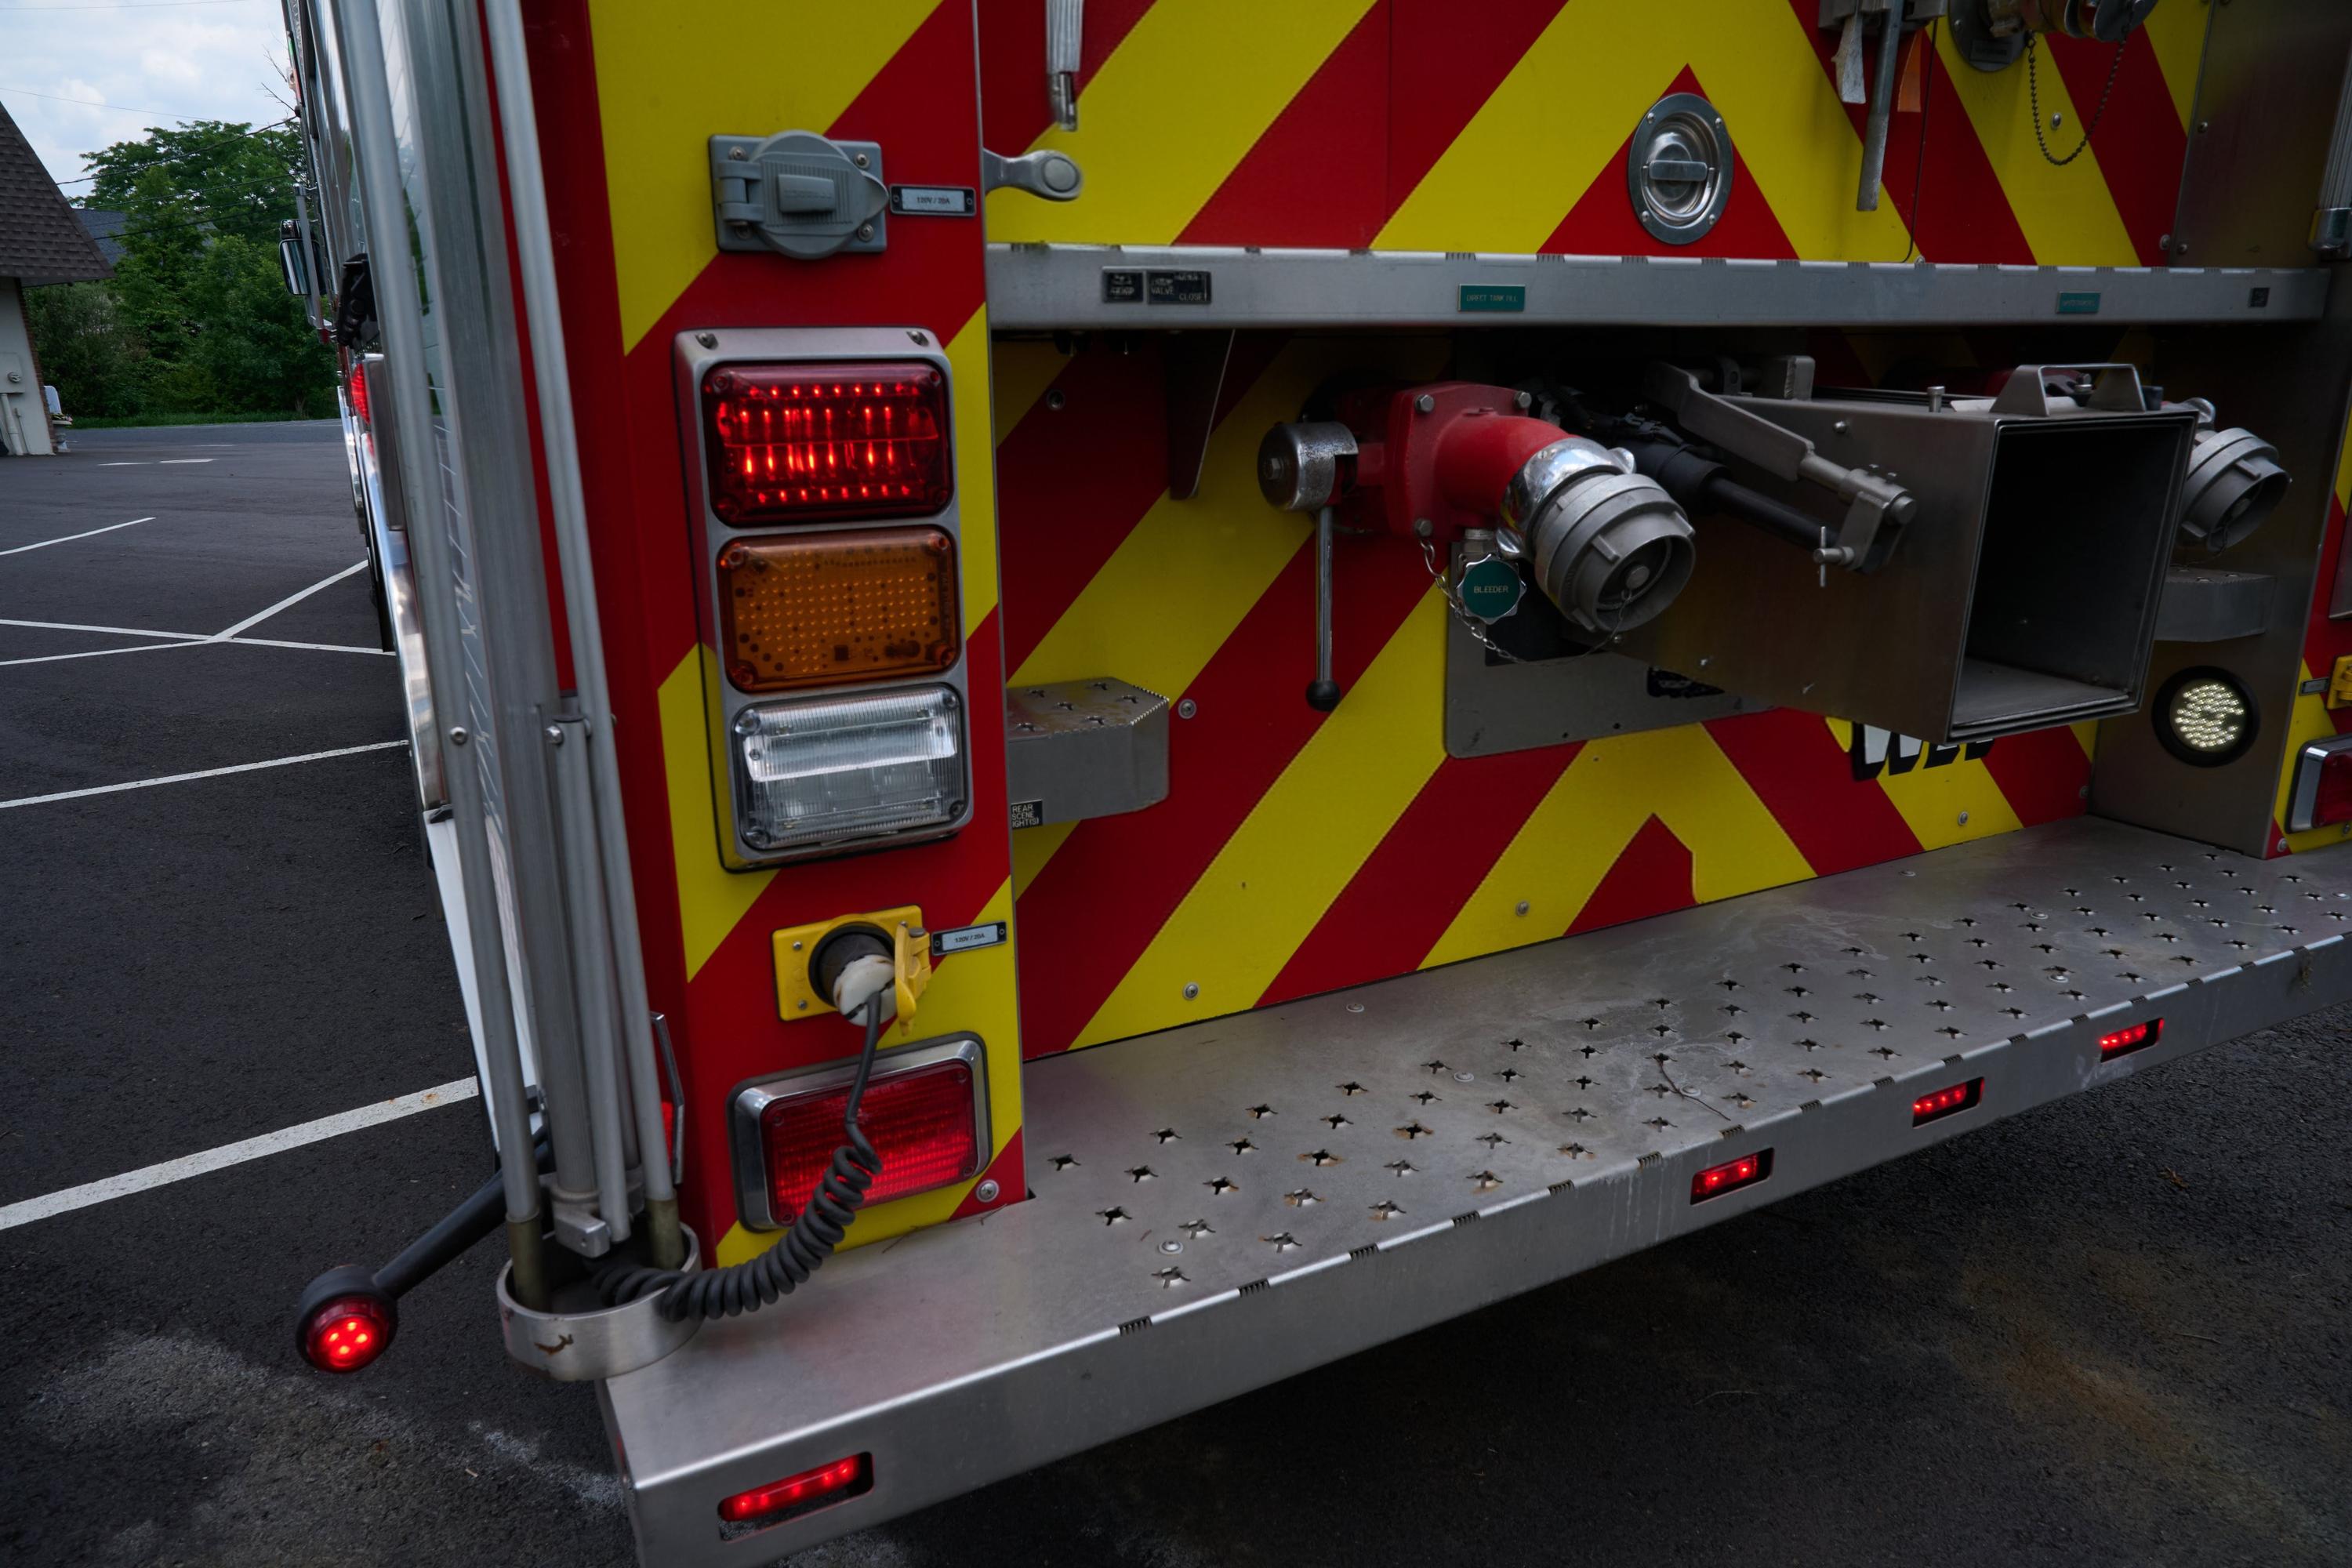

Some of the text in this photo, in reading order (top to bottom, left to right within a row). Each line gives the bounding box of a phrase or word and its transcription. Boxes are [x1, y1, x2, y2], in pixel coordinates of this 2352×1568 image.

[1151, 285, 1174, 296] VALVE
[1474, 585, 1509, 593] BLEEDER
[1012, 804, 1034, 813] REAR
[1011, 810, 1035, 821] SCENE
[1012, 817, 1040, 829] IGHT(S)
[955, 935, 970, 943] 120V
